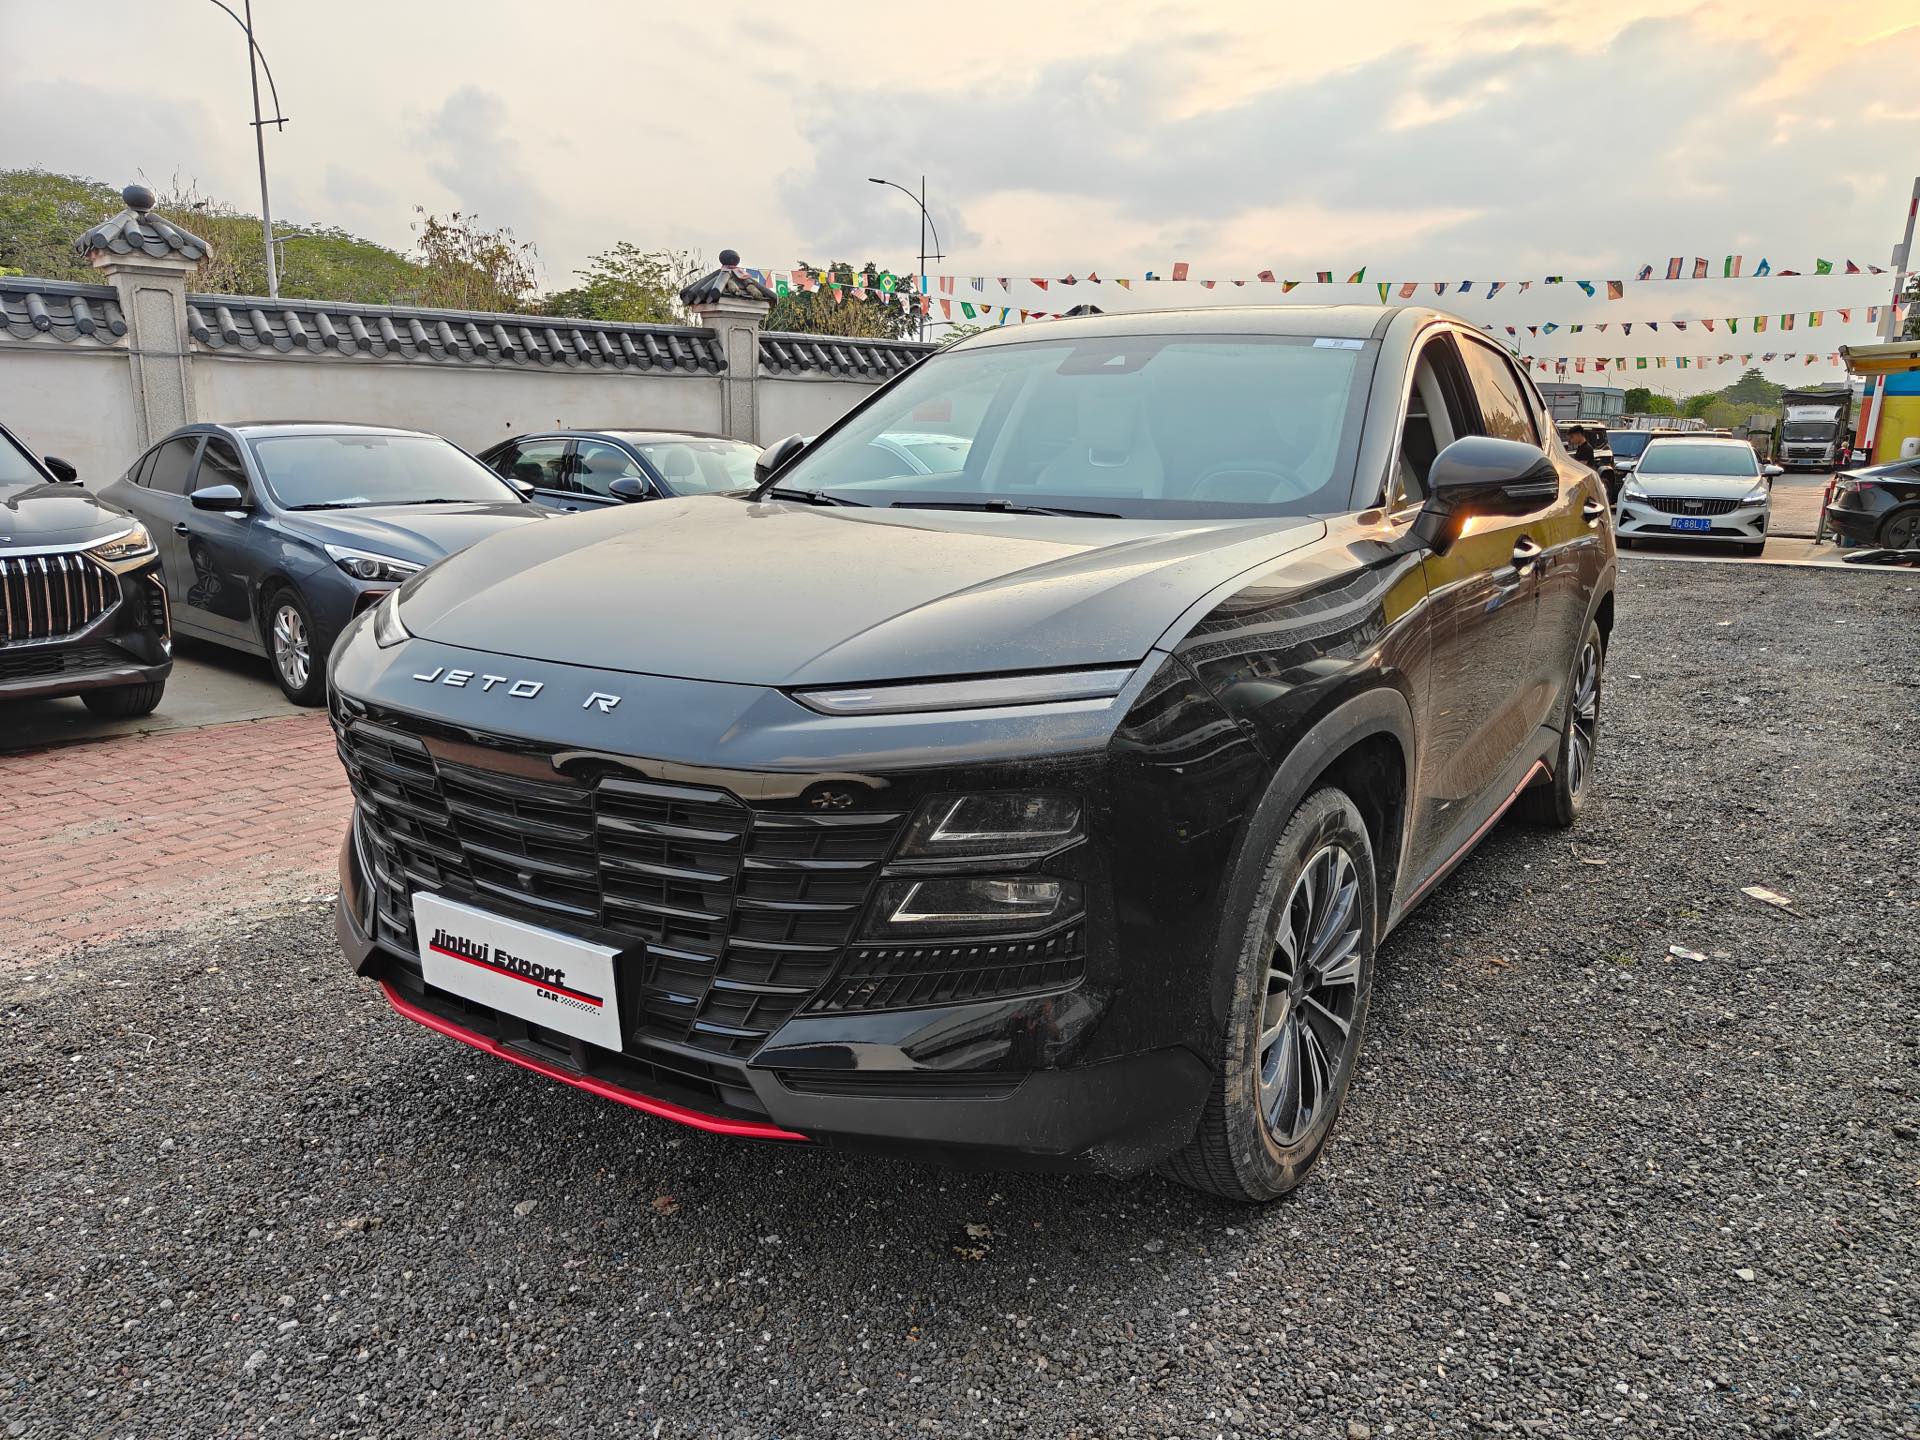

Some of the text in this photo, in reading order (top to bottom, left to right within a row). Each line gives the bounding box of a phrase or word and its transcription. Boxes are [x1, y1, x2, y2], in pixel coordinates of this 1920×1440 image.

[413, 667, 622, 713] JETO R
[430, 929, 565, 986] JinHui Export
[536, 988, 559, 1002] CAR
